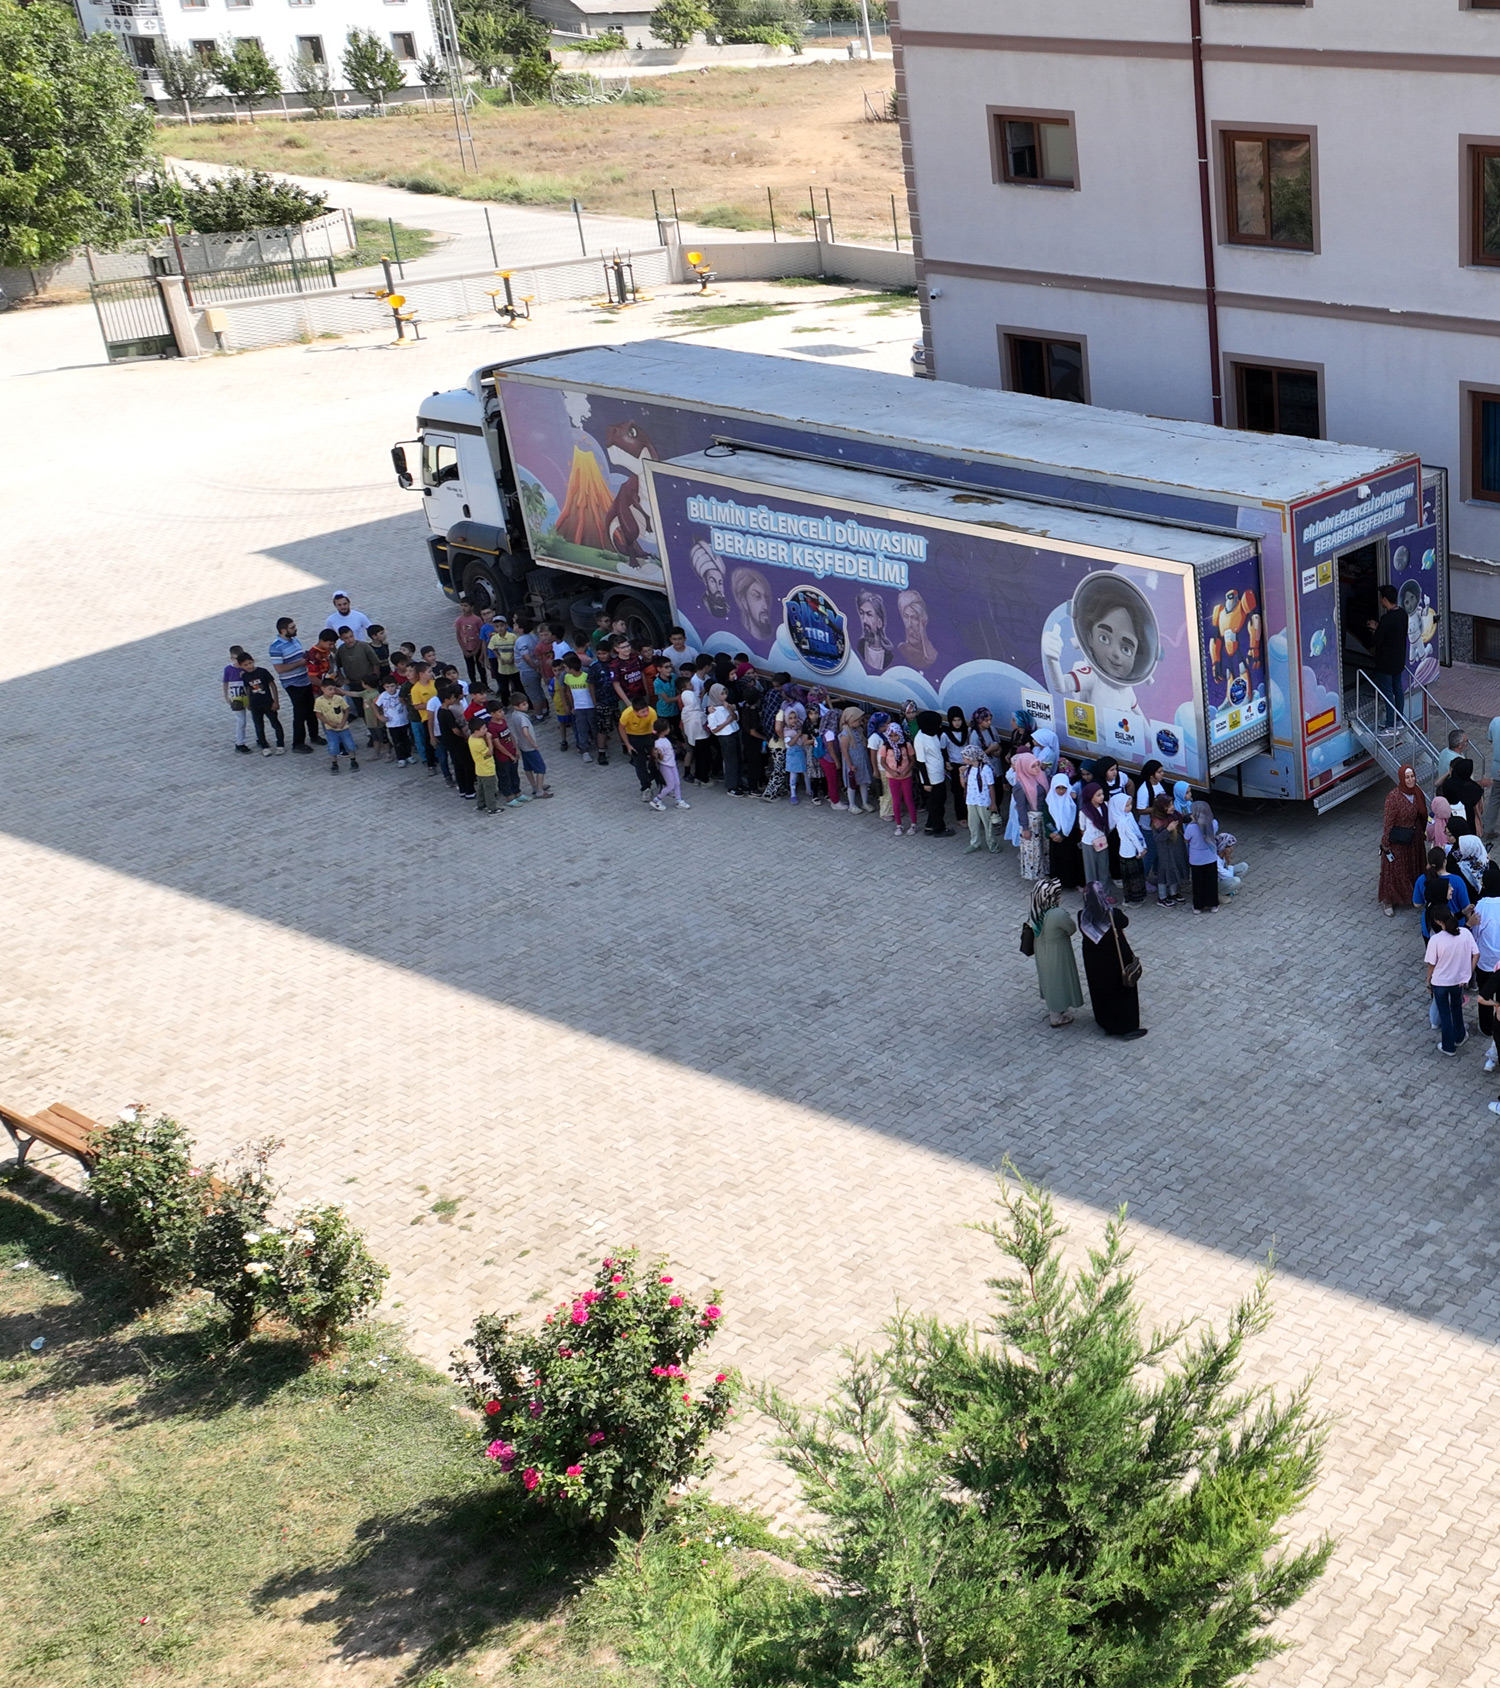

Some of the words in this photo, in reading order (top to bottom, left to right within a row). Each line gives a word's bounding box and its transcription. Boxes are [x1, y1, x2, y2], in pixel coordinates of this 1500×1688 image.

[689, 499, 746, 527] BİLİMİN
[749, 509, 832, 542] EĞLENCELİ
[834, 522, 924, 558] DÜNYASINI
[1315, 528, 1353, 553] BERABER
[713, 533, 789, 563] BERABER
[792, 546, 907, 585] KEŞFEDELİM!
[805, 627, 830, 643] TIRI
